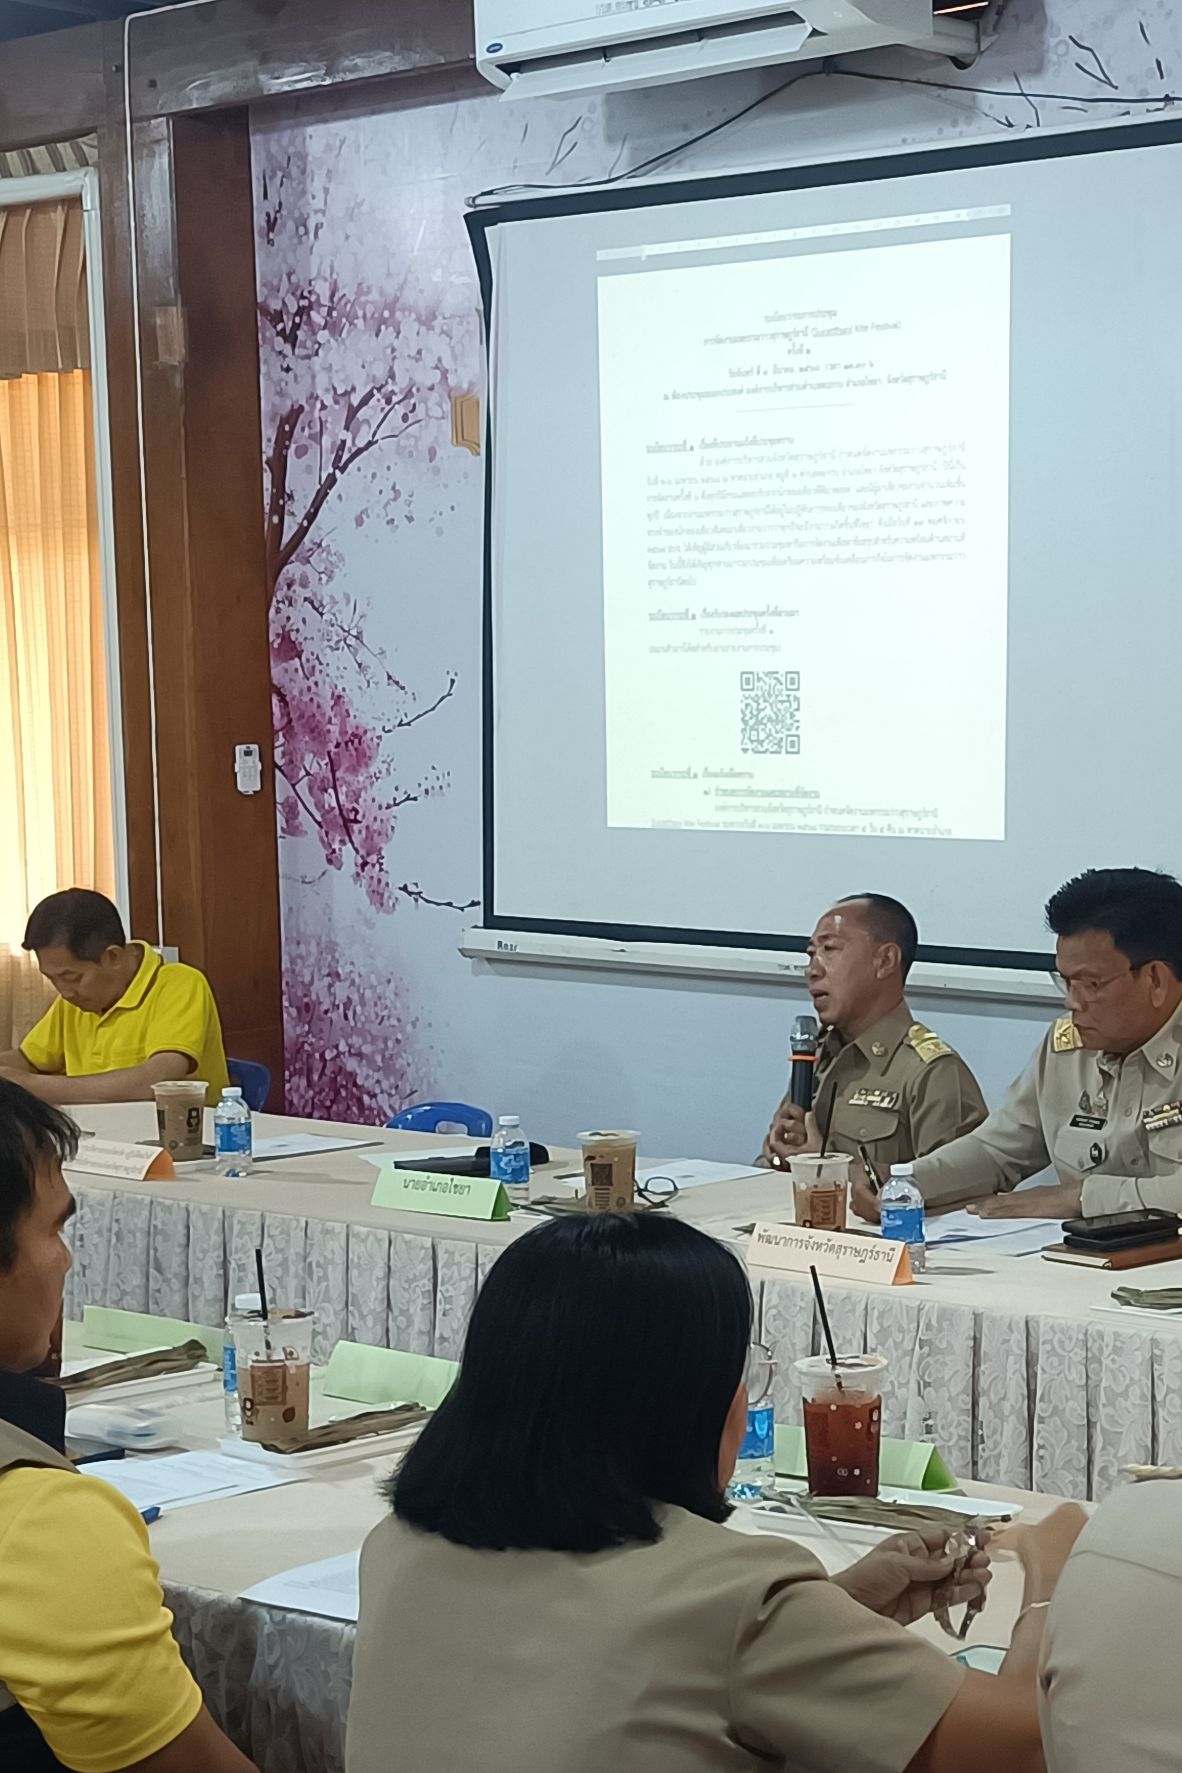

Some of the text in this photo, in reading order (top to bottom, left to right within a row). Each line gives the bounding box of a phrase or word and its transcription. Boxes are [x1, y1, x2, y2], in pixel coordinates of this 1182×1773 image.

[403, 1175, 471, 1196] นายอำเภอไชยา
[757, 1228, 896, 1263] พัฒนาการจังหวัดสุราษฎร์ธานี
